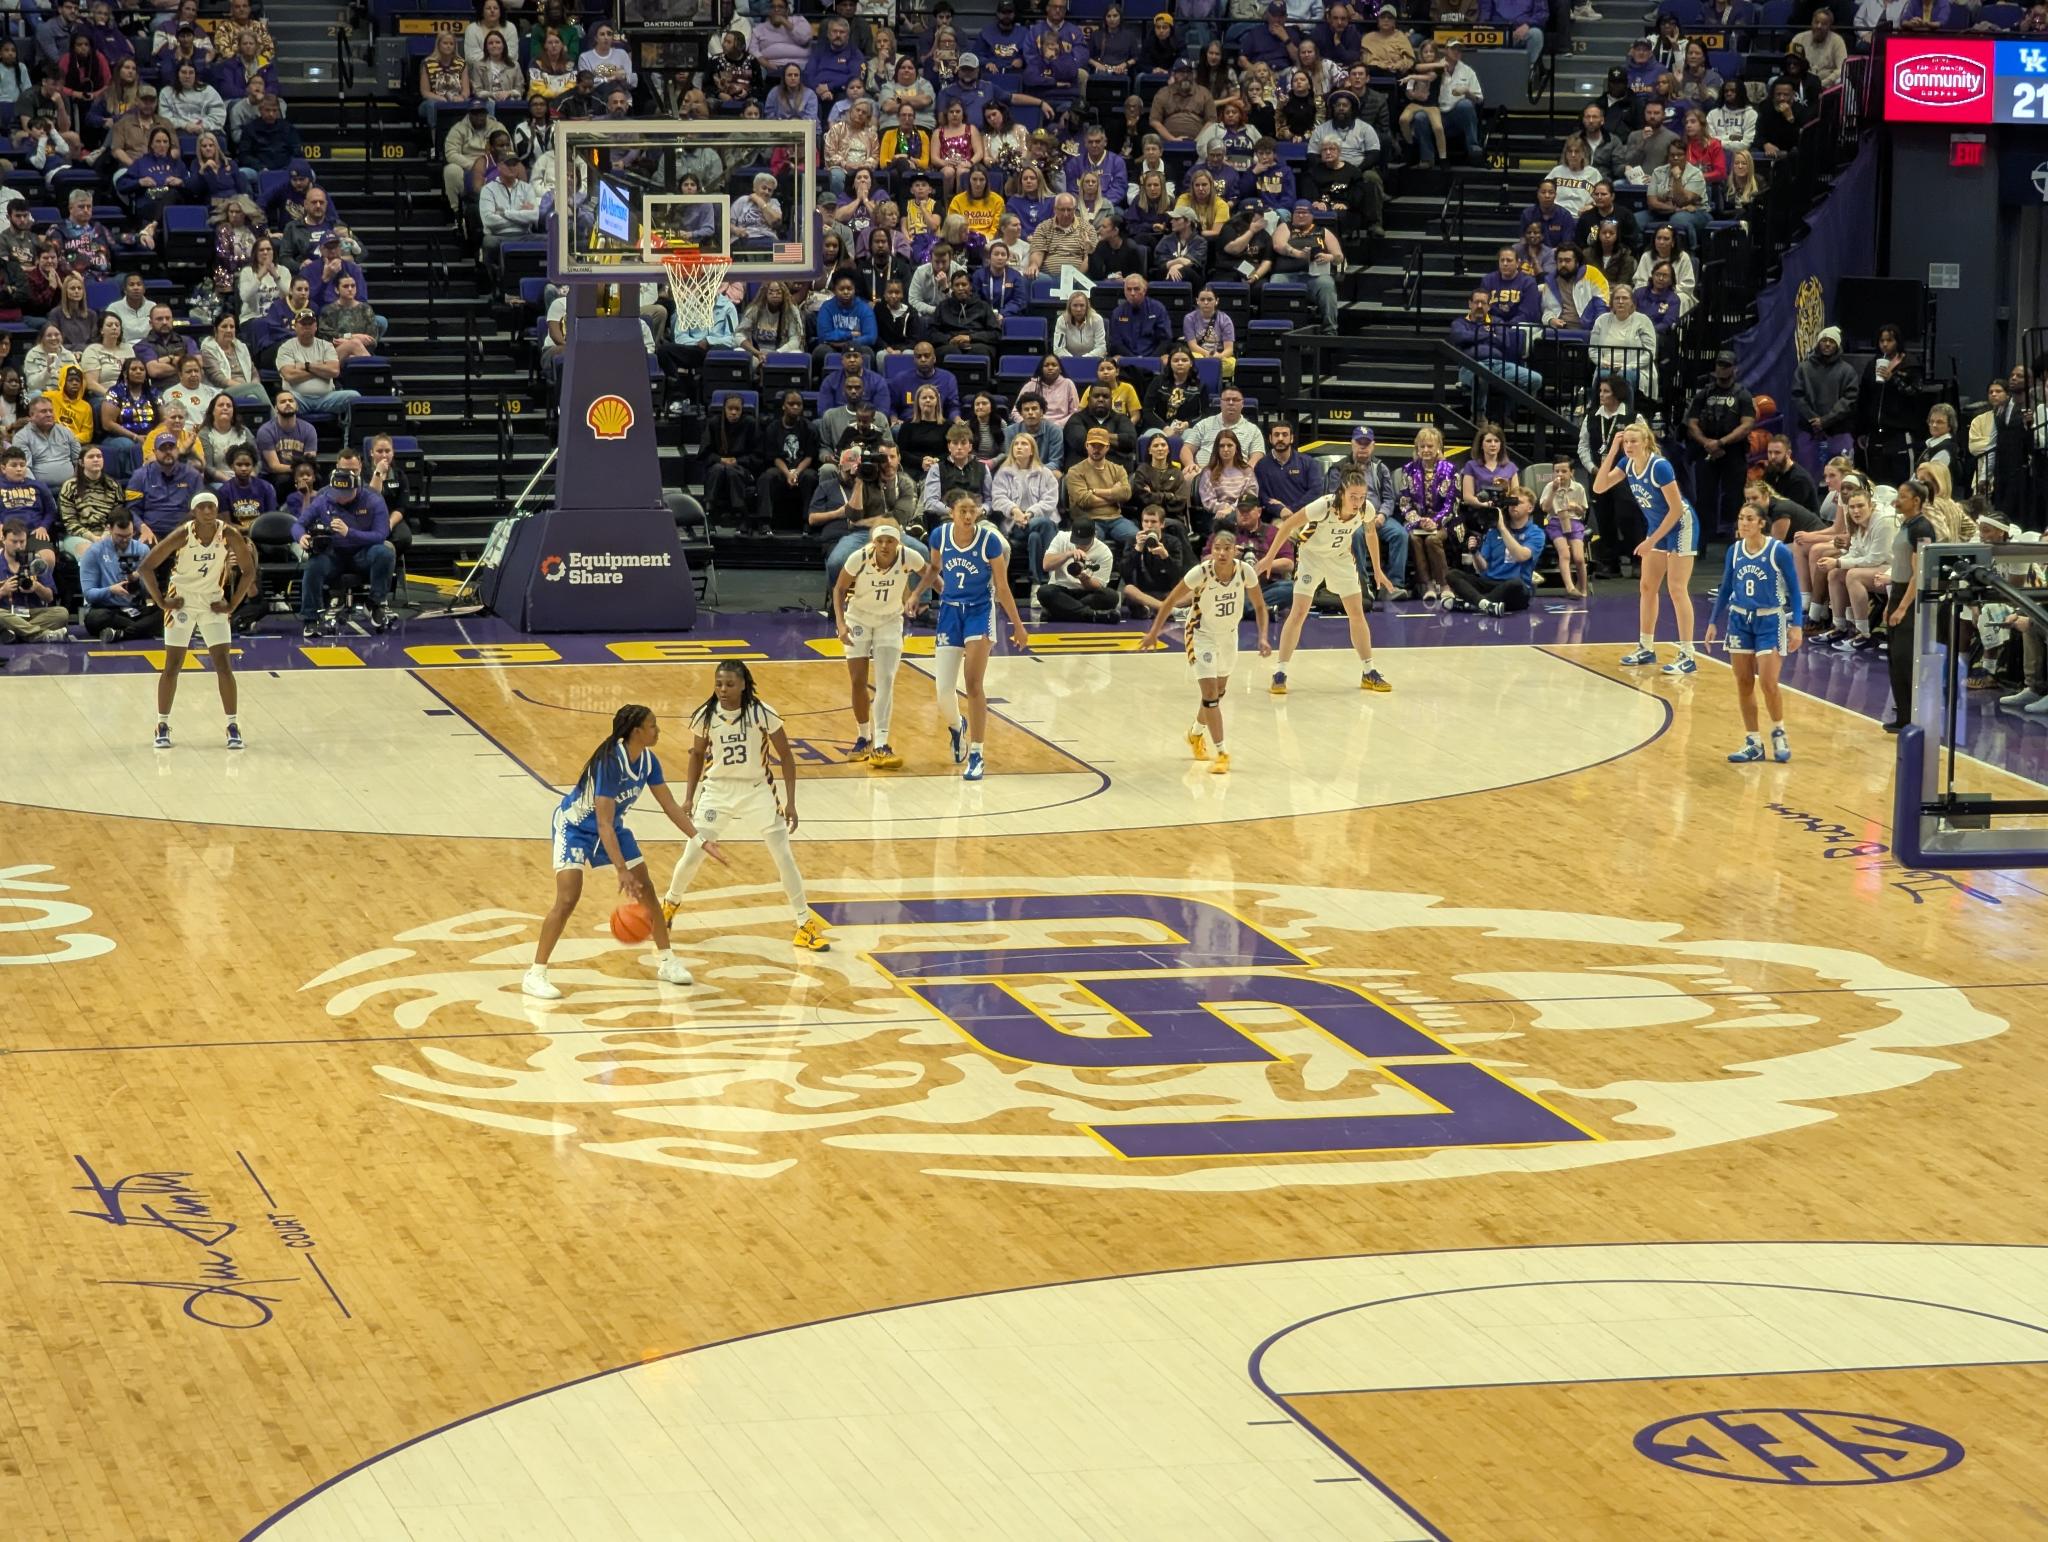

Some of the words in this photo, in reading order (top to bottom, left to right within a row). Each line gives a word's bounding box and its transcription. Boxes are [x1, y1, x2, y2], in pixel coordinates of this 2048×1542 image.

[430, 22, 463, 33] 109
[1463, 32, 1497, 44] 109
[2018, 48, 2047, 73] UK
[1899, 68, 1980, 93] Community
[2011, 82, 2048, 119] 21
[382, 145, 404, 158] 109
[1556, 178, 1582, 188] STATE
[1489, 288, 1521, 304] LSU
[405, 401, 431, 415] 108
[333, 480, 348, 488] LSU
[1331, 536, 1344, 548] 2
[193, 553, 216, 562] LSU
[569, 552, 671, 570] Equipment
[197, 563, 209, 578] 4
[944, 557, 979, 575] KENTUCKY
[1736, 564, 1768, 582] KENTUCKY
[569, 569, 624, 585] Share
[871, 579, 895, 588] LSU
[956, 571, 965, 590] 7
[875, 588, 889, 602] 11
[1745, 579, 1755, 597] 8
[1215, 591, 1237, 602] LSU
[1215, 601, 1235, 617] 30
[720, 734, 748, 743] LSU
[723, 744, 748, 766] 23
[806, 891, 1606, 1161] LSU
[266, 1212, 317, 1250] COURT
